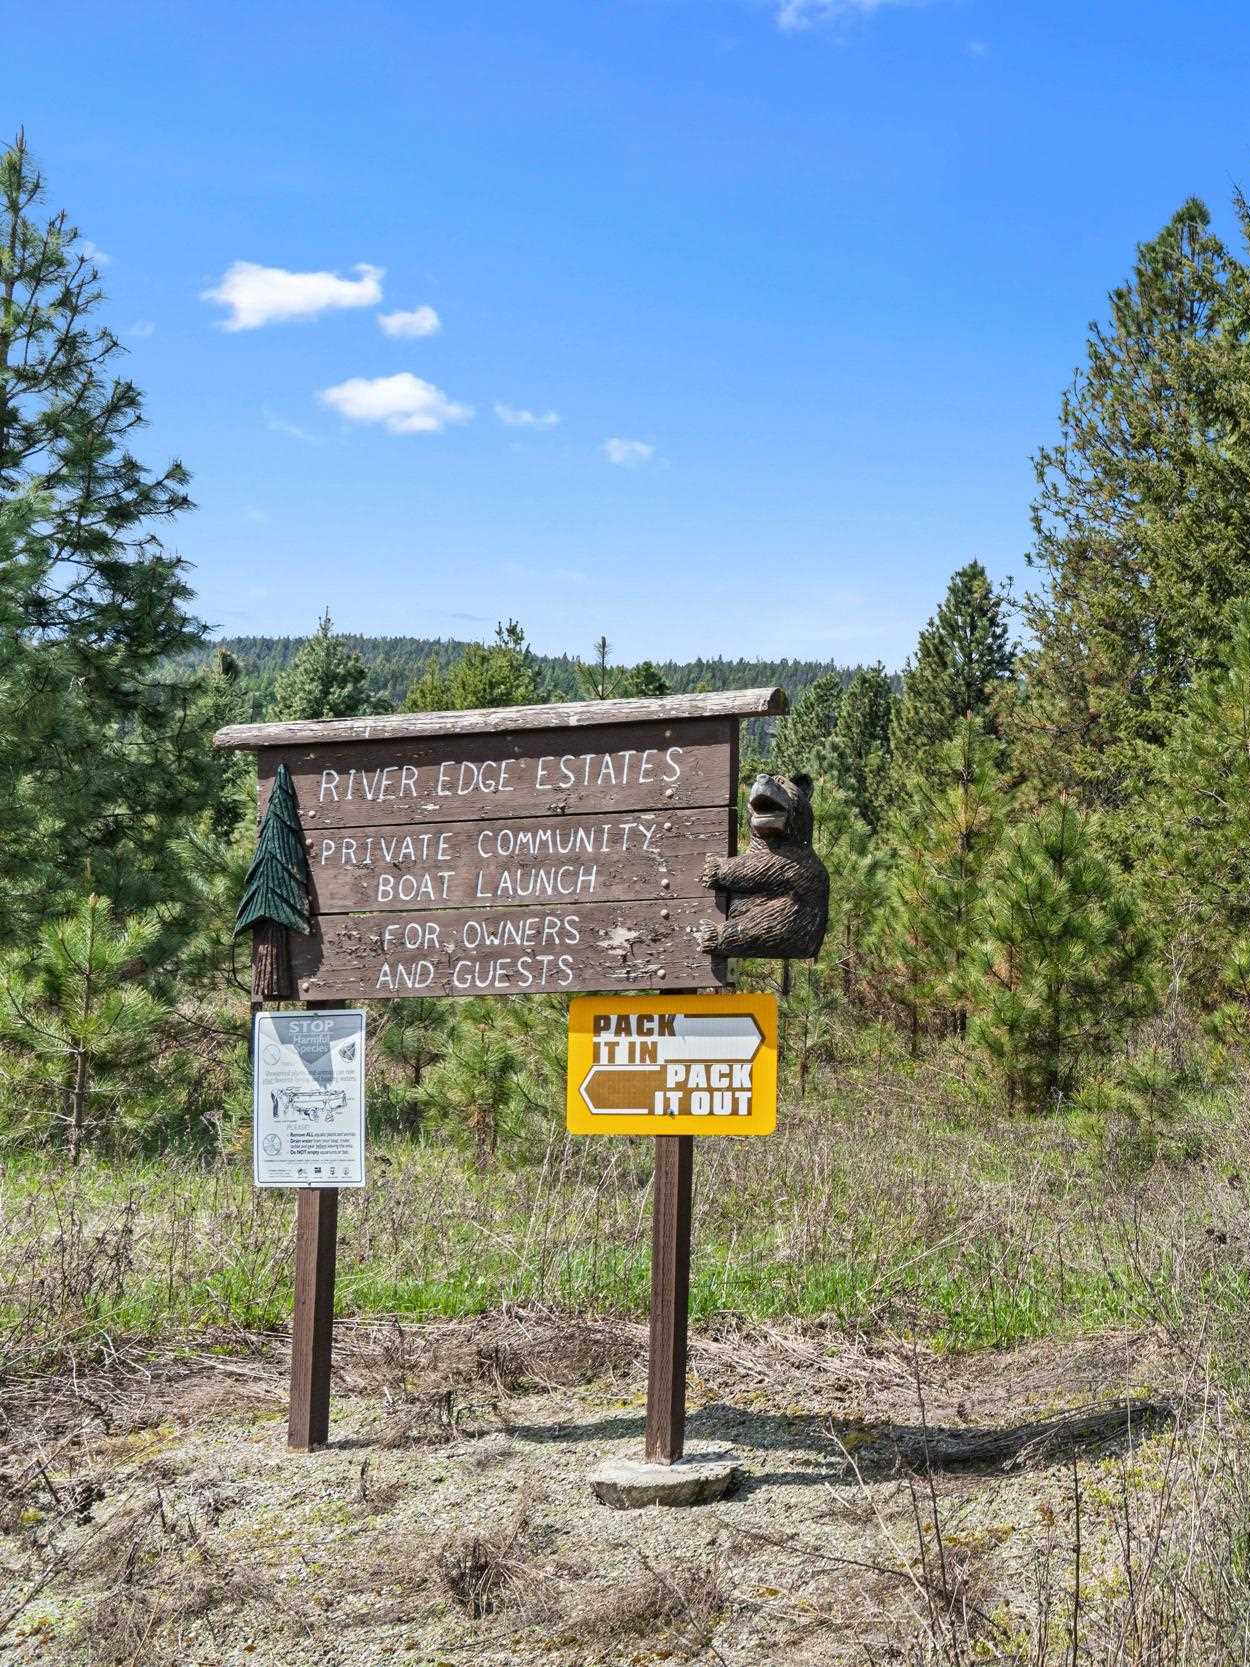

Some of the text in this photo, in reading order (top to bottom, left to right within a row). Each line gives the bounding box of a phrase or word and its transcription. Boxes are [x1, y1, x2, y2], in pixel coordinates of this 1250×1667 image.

[319, 747, 683, 802] RIVER EDGE ESTATES
[321, 823, 660, 865] PRIVATE COMMUNITY
[377, 864, 597, 902] BOAT LAUNCH
[383, 915, 580, 951] FOR OWNERS
[376, 955, 575, 990] AND GUESTS
[289, 1020, 334, 1033] STOP
[593, 1014, 677, 1037] PACK
[293, 1034, 330, 1043] Harmful
[592, 1041, 658, 1064] IT IN
[666, 1064, 752, 1089] PACK
[654, 1091, 752, 1115] IT OUT
